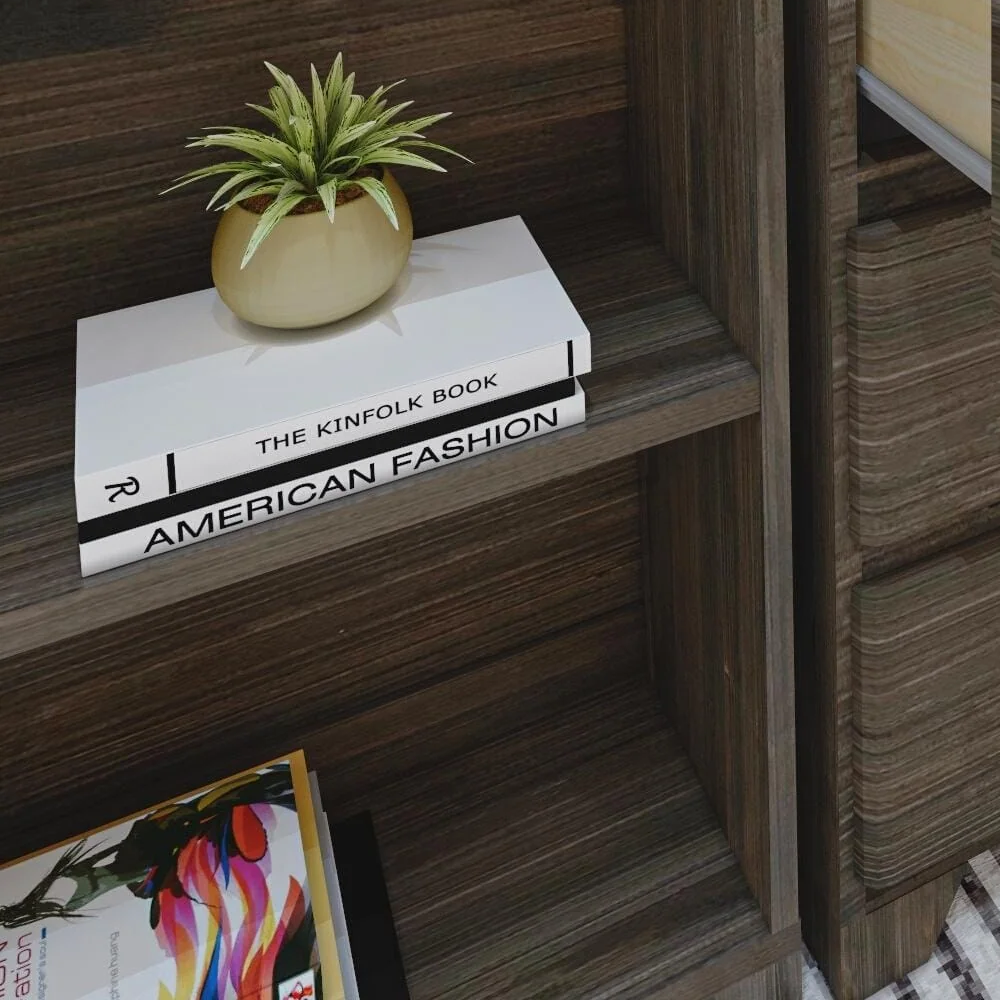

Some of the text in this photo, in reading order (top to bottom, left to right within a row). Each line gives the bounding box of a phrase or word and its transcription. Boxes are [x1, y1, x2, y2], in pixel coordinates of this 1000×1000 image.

[255, 372, 498, 454] THE KINFOLK BOOK
[143, 407, 558, 554] AMERICAN FASHION
